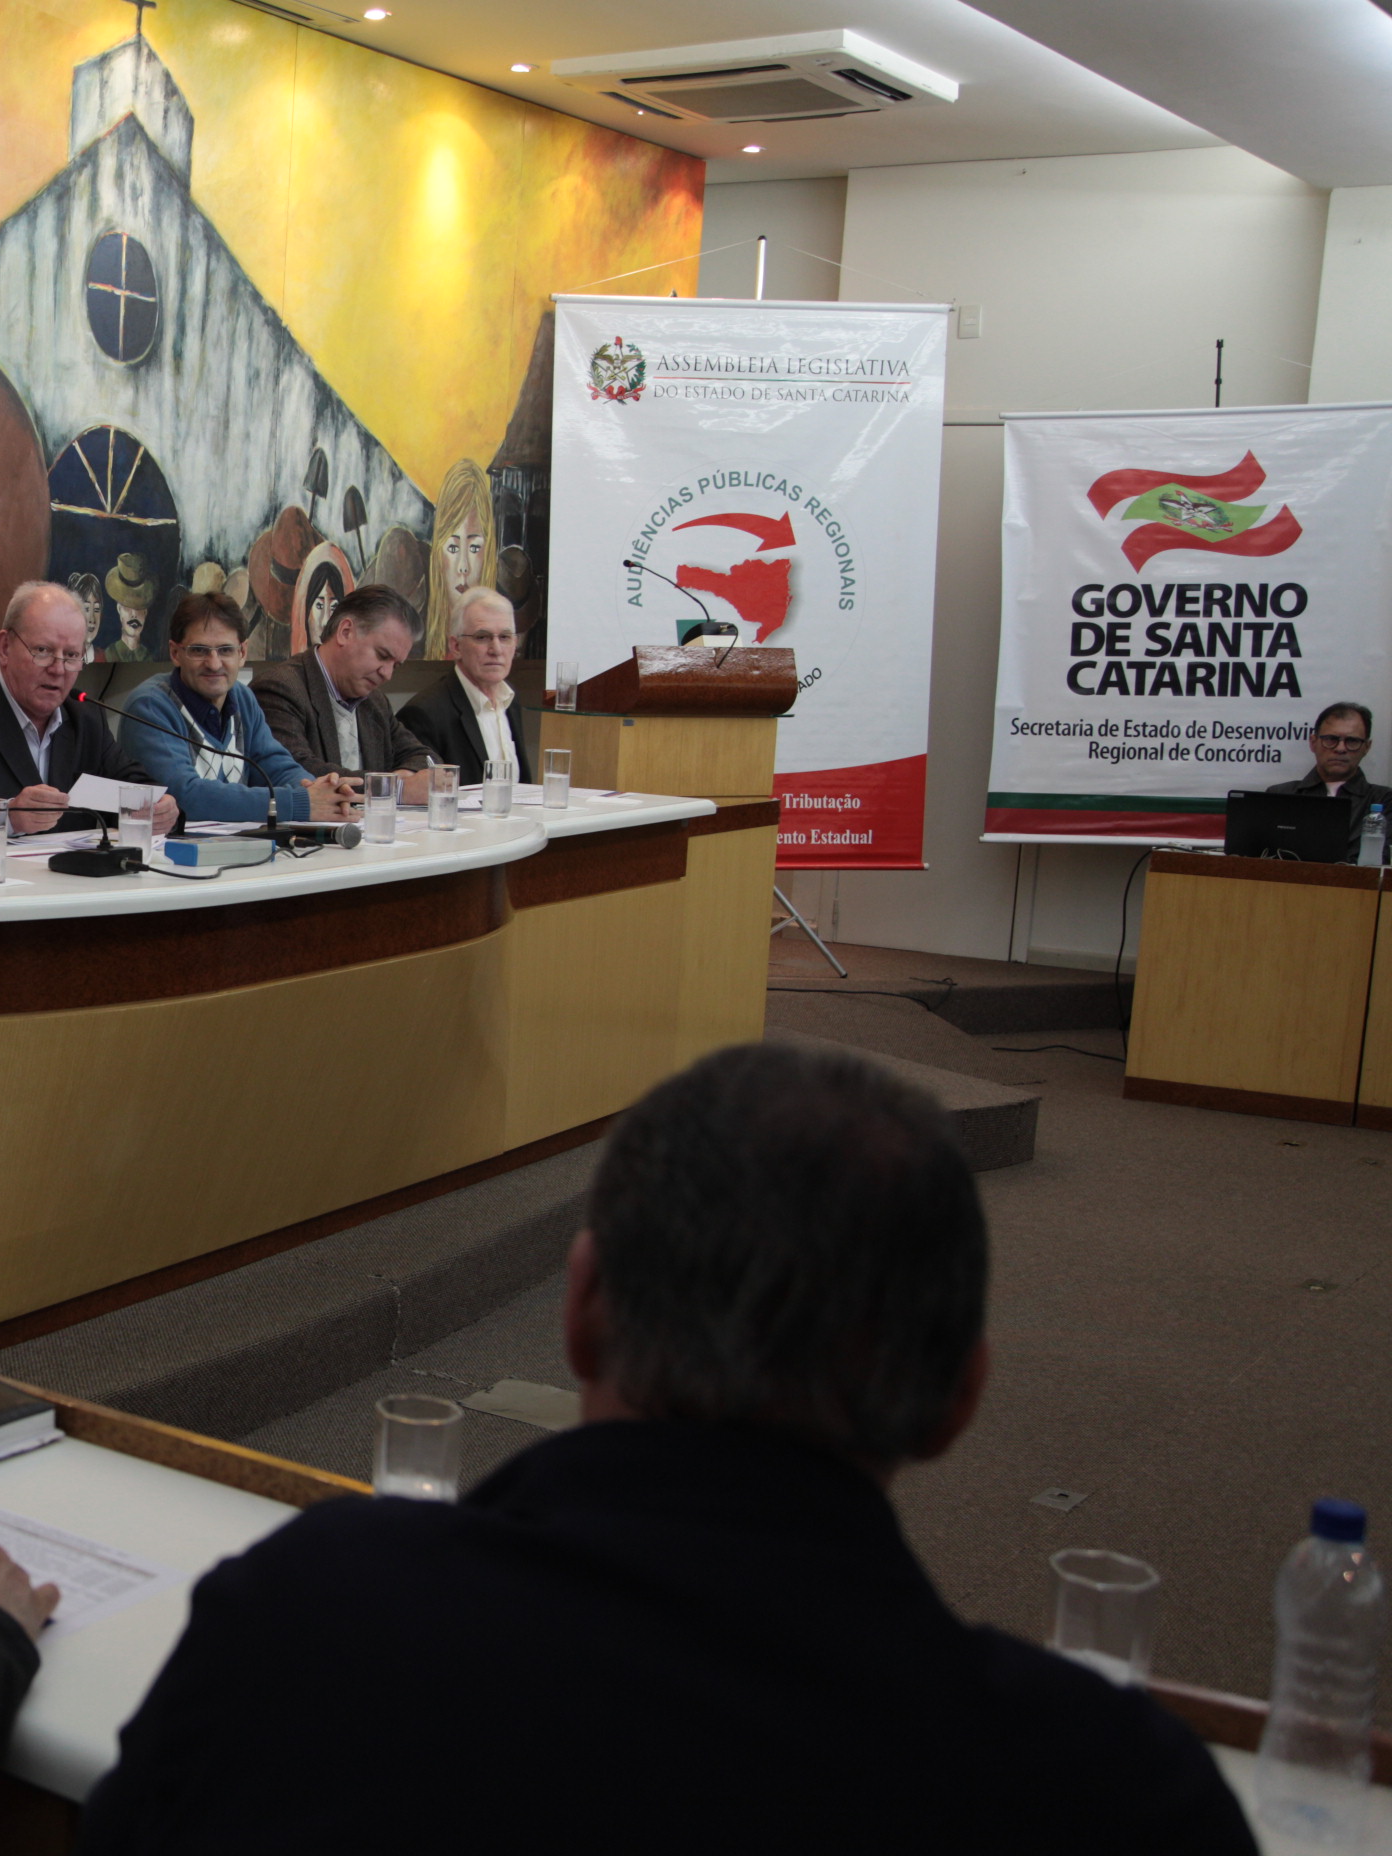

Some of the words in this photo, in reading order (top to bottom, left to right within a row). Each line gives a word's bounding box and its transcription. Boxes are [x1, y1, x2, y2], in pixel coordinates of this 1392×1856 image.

[656, 354, 778, 374] ASSEMBLEIA
[786, 357, 910, 377] LEGISLATIVA
[653, 384, 679, 399] DO
[684, 385, 745, 401] ESTADO
[751, 386, 772, 400] DE
[776, 387, 827, 402] SANTA
[832, 388, 910, 403] CATARINA
[626, 486, 694, 608] AUDIÊNCIAS
[697, 469, 803, 502] PÚBLICAS
[803, 496, 856, 611] REGIONAIS
[1071, 582, 1308, 619] GOVERNO
[1070, 622, 1132, 657] DE
[1144, 621, 1302, 658] SANTA
[797, 667, 822, 693] ADO
[1066, 660, 1302, 698] CATARINA
[1010, 717, 1094, 737] Secretaria
[1098, 718, 1119, 738] de
[1123, 719, 1181, 739] Estado
[1185, 719, 1208, 739] de
[1088, 741, 1165, 765] Regional
[1168, 742, 1190, 761] de
[1194, 743, 1282, 763] Concórdia
[782, 793, 861, 812] Tributação
[776, 830, 806, 845] ento
[810, 829, 873, 845] Estadual
